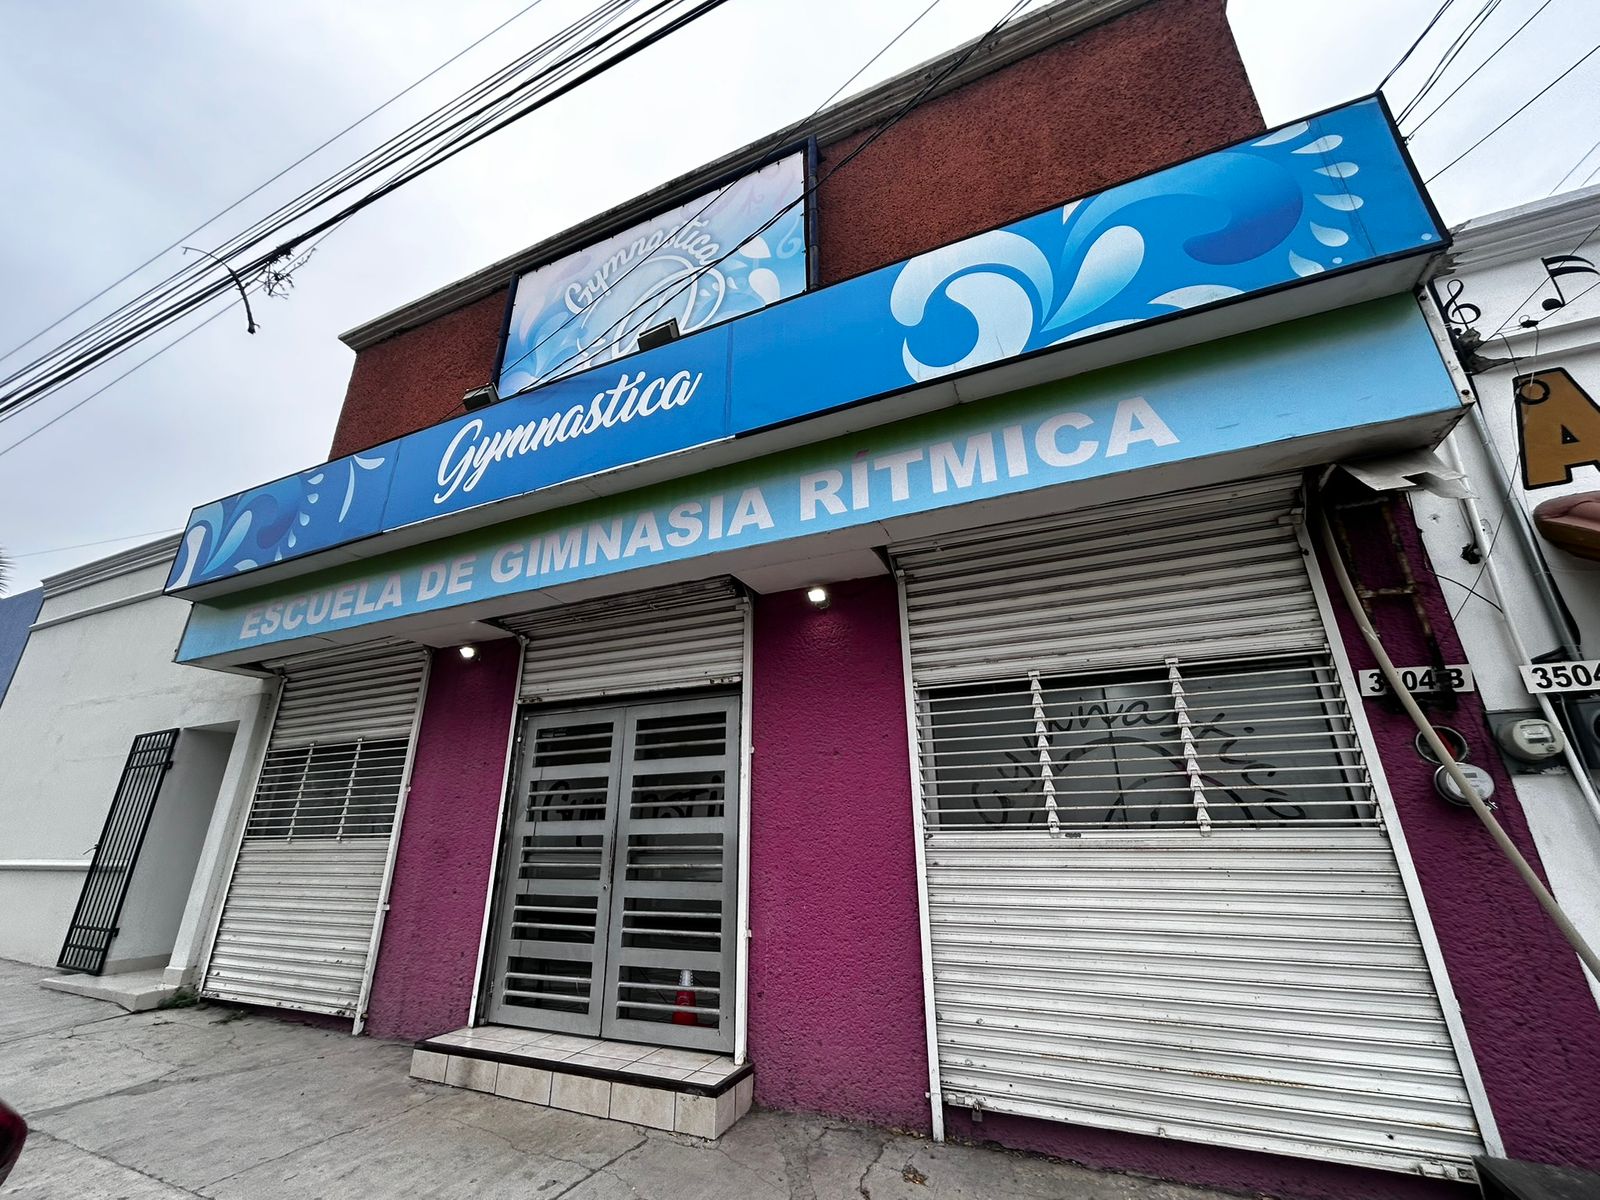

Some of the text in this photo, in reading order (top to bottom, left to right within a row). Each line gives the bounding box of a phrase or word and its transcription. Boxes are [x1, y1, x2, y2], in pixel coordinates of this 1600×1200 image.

[565, 216, 719, 315] Gymnastica
[433, 370, 703, 504] Gymnastica
[239, 396, 1180, 640] ESCUELA DE GIMNASIA RÍTMICA
